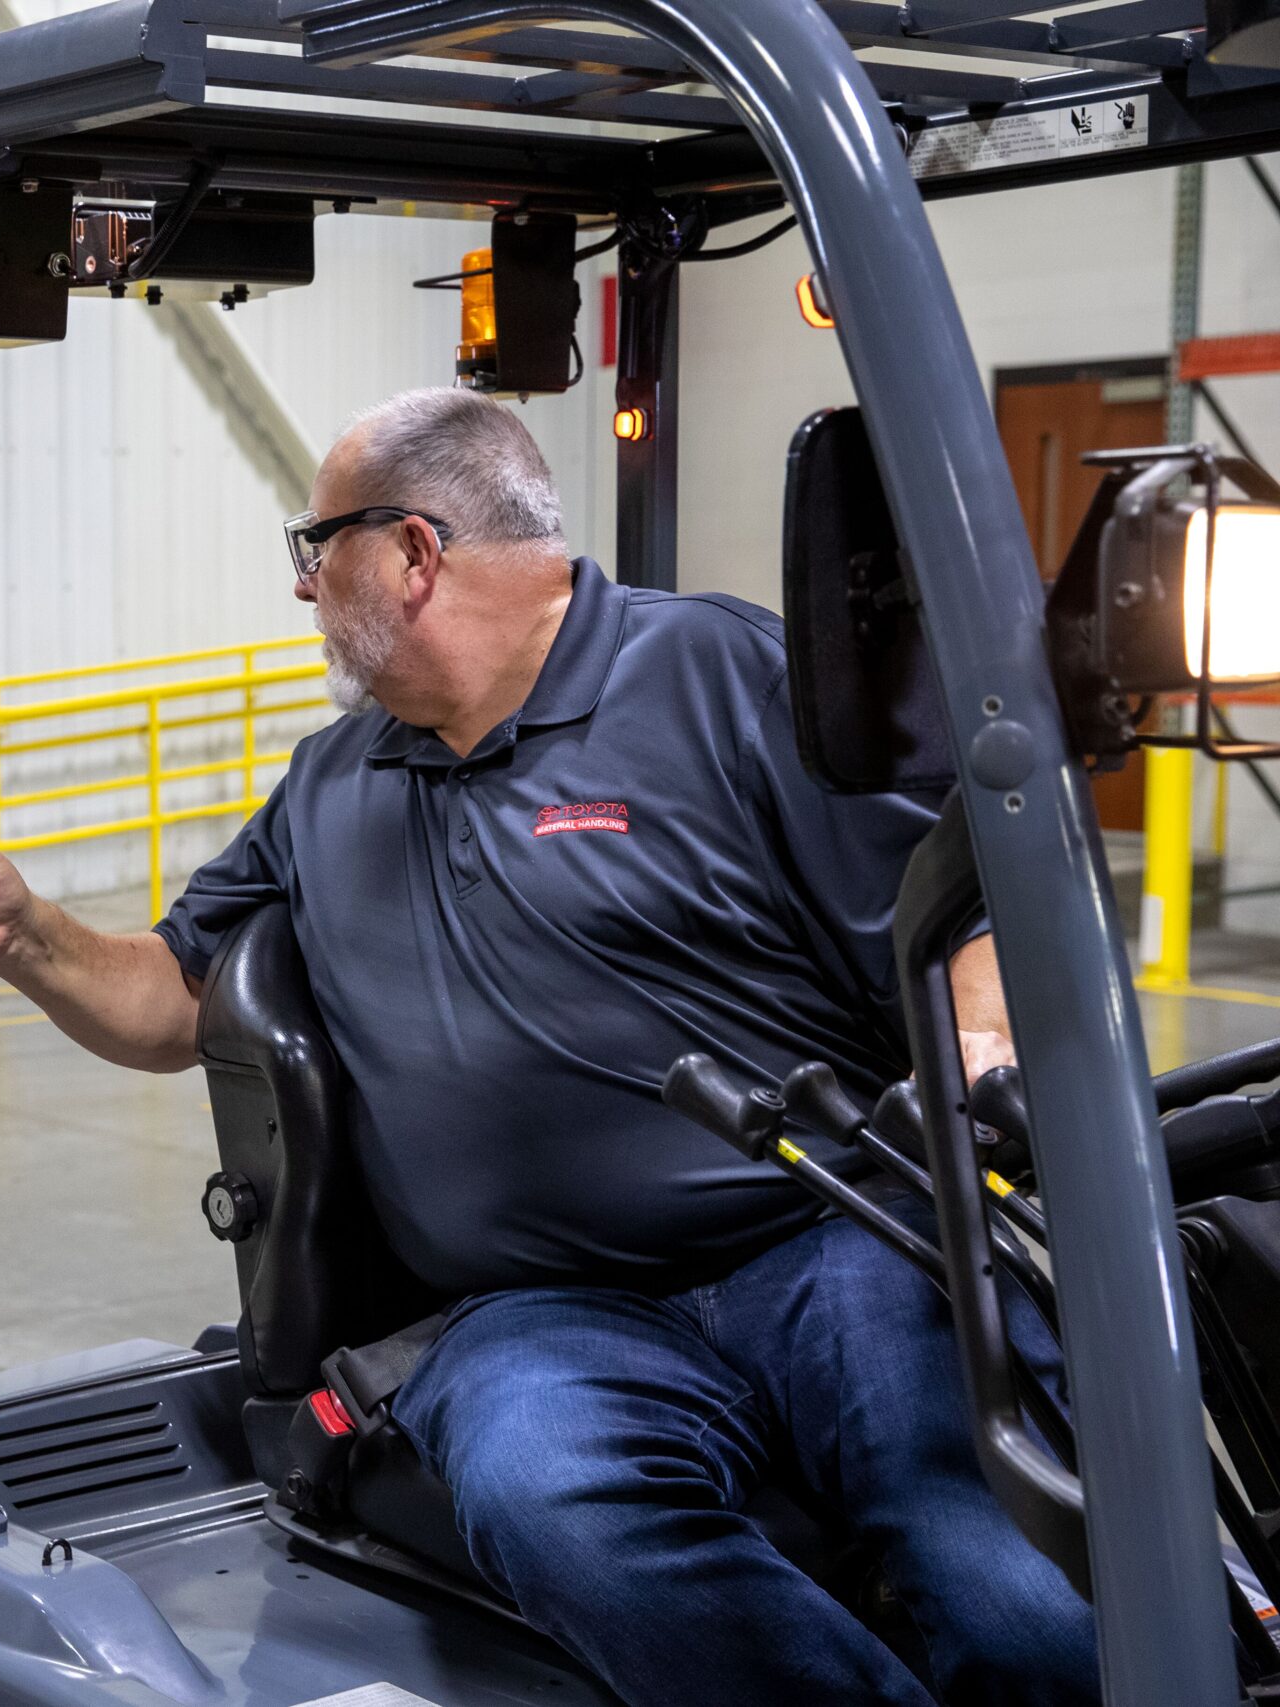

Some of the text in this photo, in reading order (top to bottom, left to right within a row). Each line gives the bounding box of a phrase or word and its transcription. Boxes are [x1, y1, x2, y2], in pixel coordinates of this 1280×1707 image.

[563, 802, 629, 818] TOYOTA
[536, 819, 625, 835] MATERIAL HANDLING
